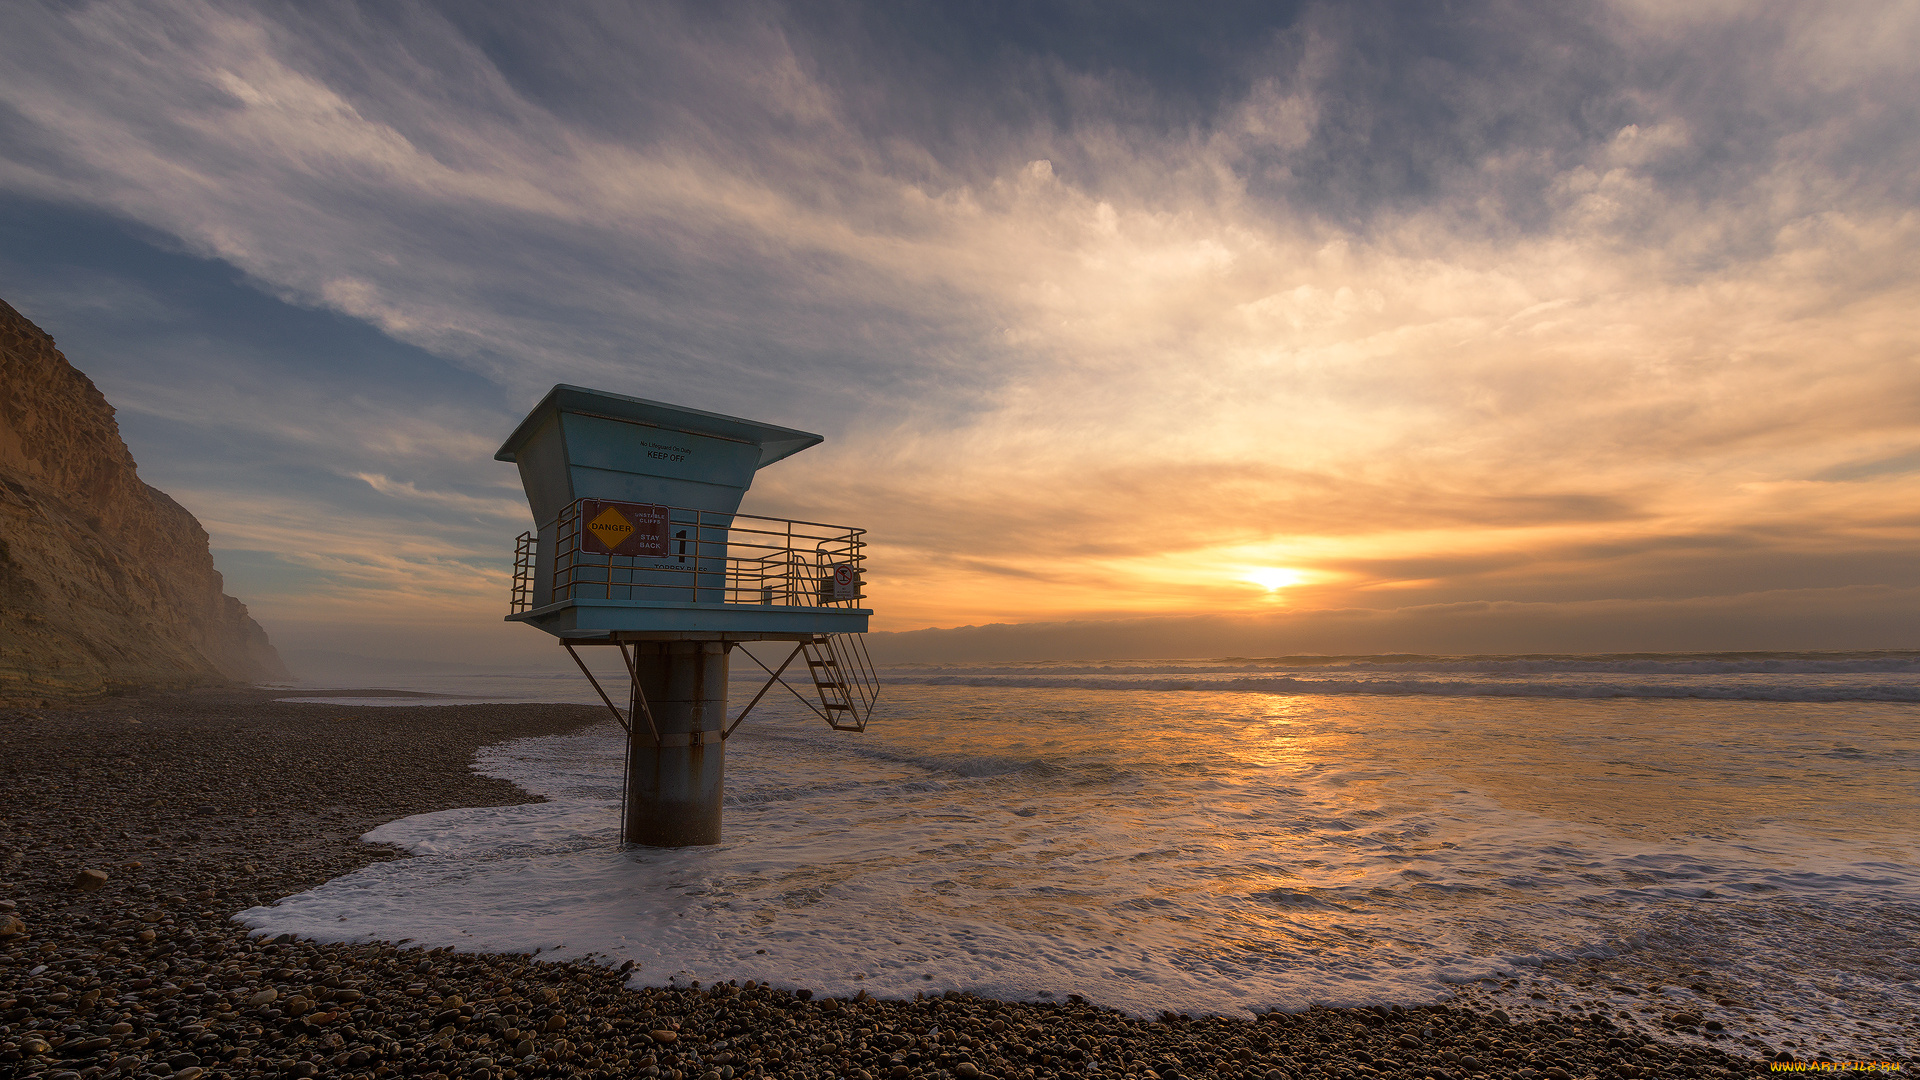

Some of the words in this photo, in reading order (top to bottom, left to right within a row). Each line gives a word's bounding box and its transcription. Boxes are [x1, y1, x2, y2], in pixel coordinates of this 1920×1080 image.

[648, 442, 672, 450] Lifeguard
[680, 447, 692, 455] Duty
[647, 450, 669, 460] KEEP
[669, 453, 685, 462] OFF
[634, 512, 665, 520] UNSTABLE
[591, 522, 632, 533] DANGER
[640, 533, 660, 541] STAY
[639, 541, 661, 549] BACK
[675, 529, 687, 564] 1
